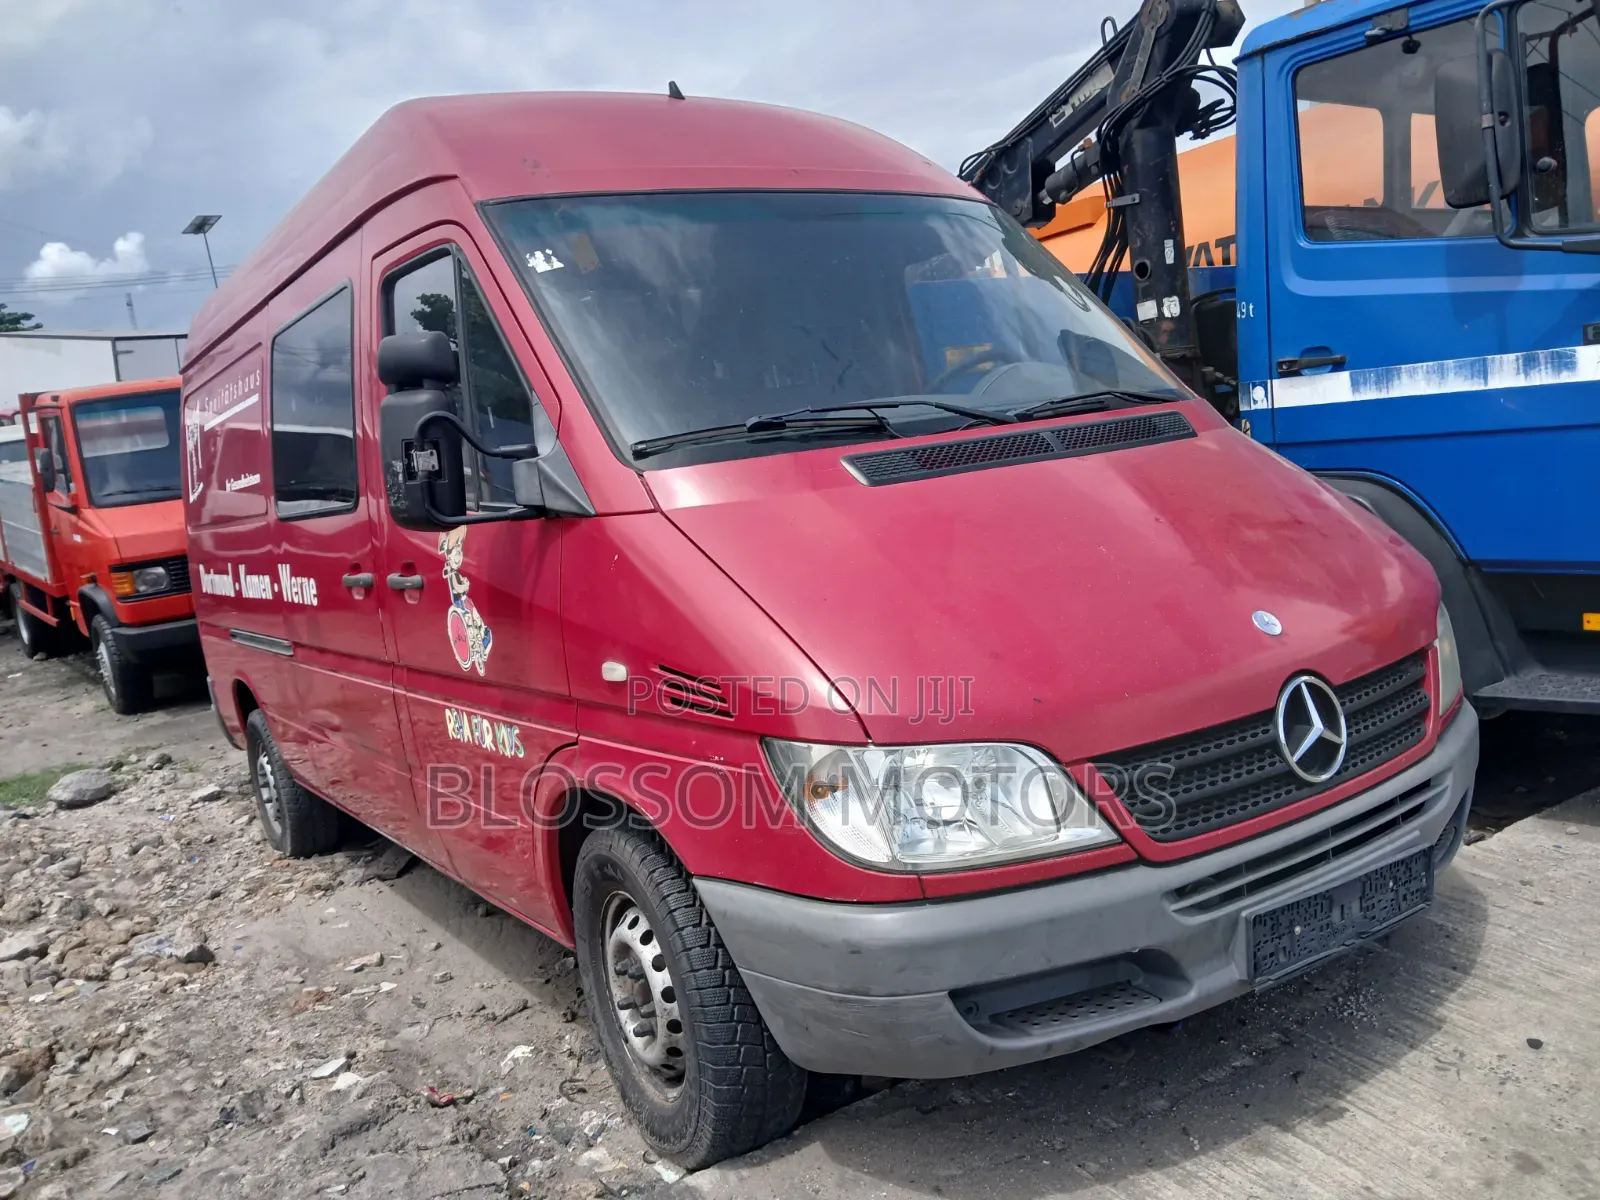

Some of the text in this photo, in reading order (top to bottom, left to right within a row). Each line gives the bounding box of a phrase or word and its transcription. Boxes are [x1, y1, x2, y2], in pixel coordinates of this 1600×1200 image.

[277, 563, 318, 607] Werne
[445, 708, 525, 759] REHA FÜR KIDS
